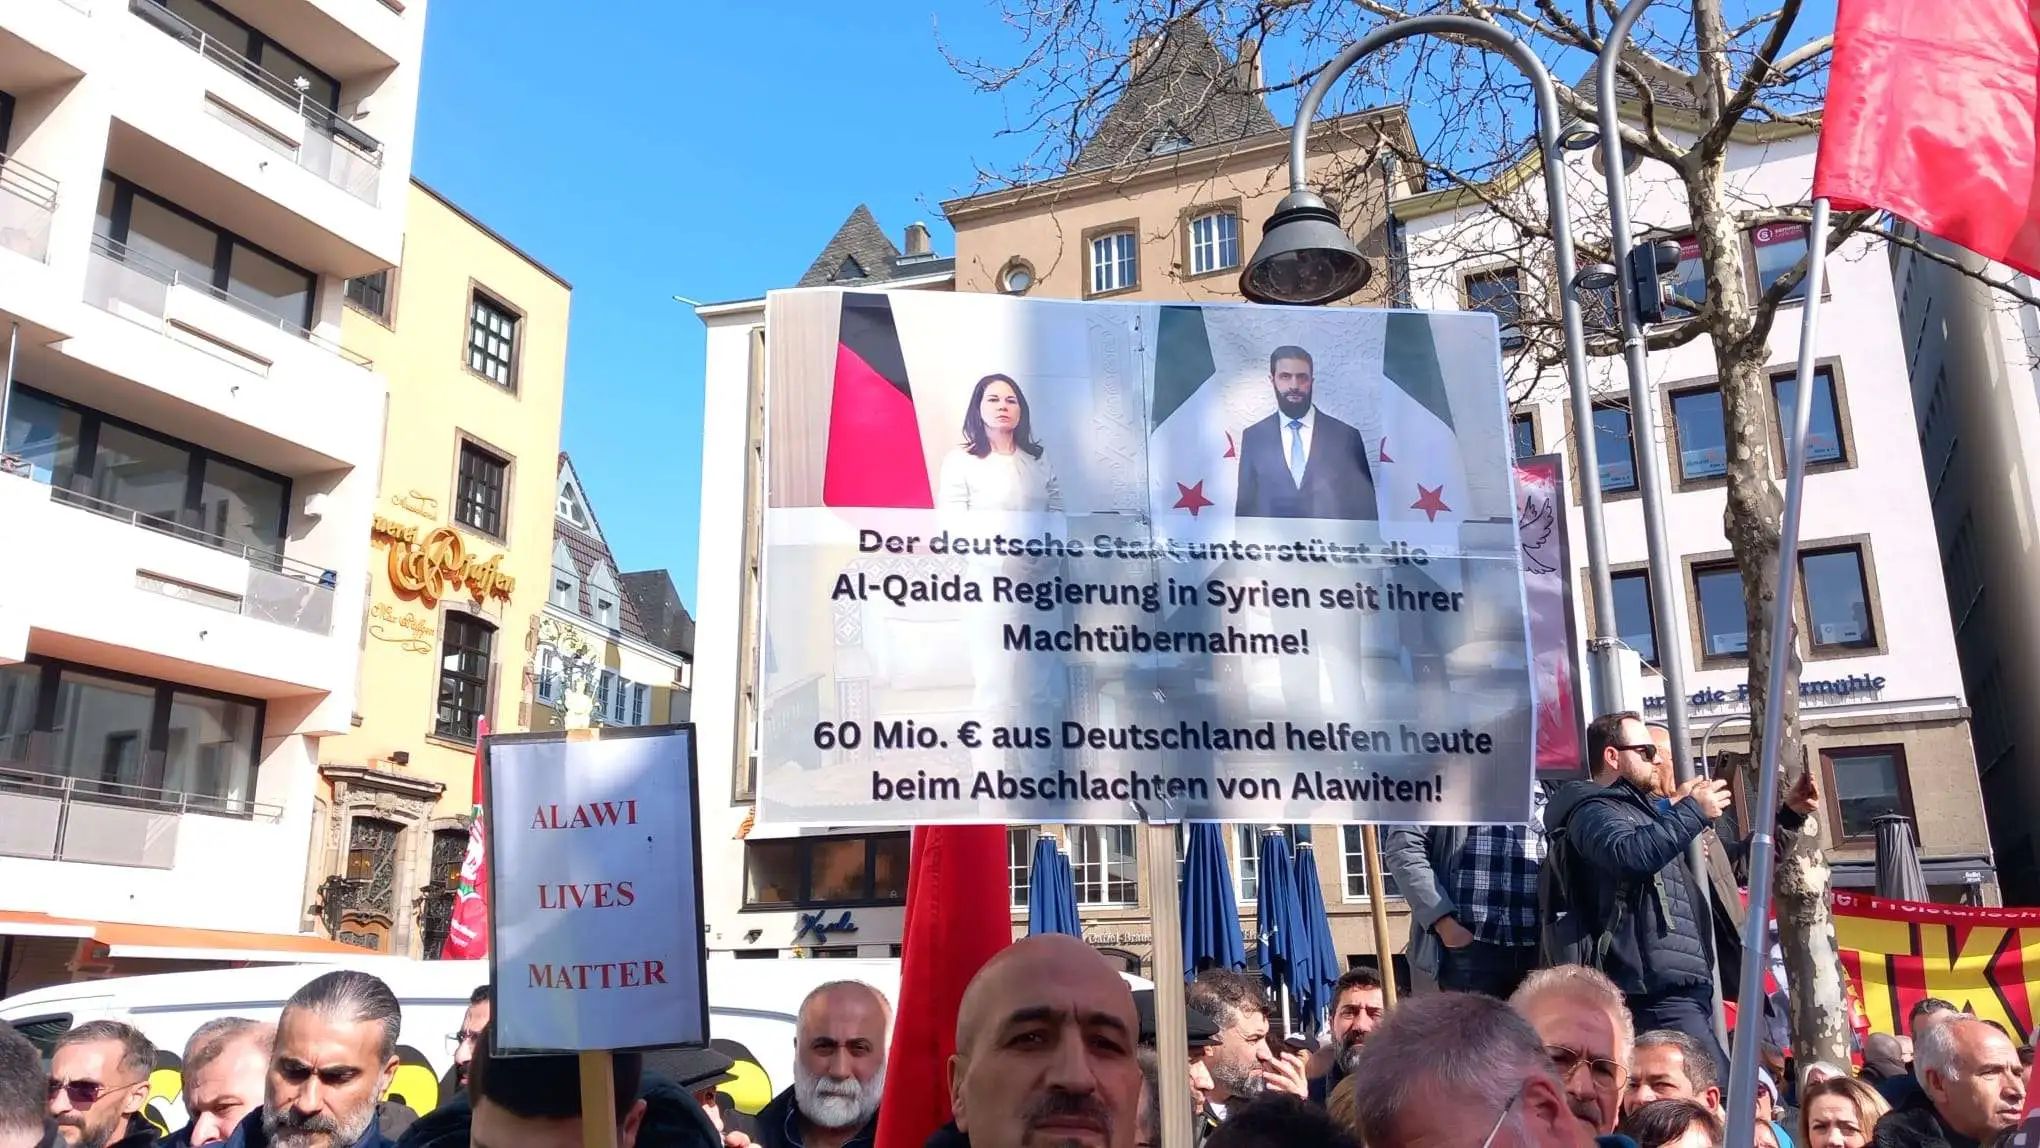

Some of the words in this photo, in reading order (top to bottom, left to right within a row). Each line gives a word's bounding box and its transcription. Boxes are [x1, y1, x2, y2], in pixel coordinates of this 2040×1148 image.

[859, 528, 921, 554] Der
[929, 530, 1084, 558] deutsche
[1190, 538, 1372, 564] unterstützt
[1383, 540, 1431, 567] die
[831, 572, 983, 607] Al-Qaida
[993, 576, 1159, 613] Regierung
[1166, 577, 1199, 607] in
[1206, 579, 1312, 614] Syrien
[1319, 581, 1380, 611] seit
[1386, 582, 1464, 613] ihrer
[1003, 623, 1309, 656] Machtübernahme!
[1692, 686, 1725, 706] die
[814, 720, 862, 751] 60
[872, 719, 948, 750] Mio.
[956, 721, 983, 749] €
[991, 725, 1052, 750] aus
[1061, 721, 1276, 751] Deutschland
[1286, 722, 1392, 752] helfen
[1400, 724, 1493, 754] heute
[871, 770, 960, 801] beim
[970, 770, 1208, 802] Abschlachten
[1216, 776, 1282, 801] von
[1291, 771, 1443, 803] Alawiten!
[531, 800, 640, 830] ALAWI
[537, 880, 636, 910] LIVES
[527, 959, 669, 990] MATTER
